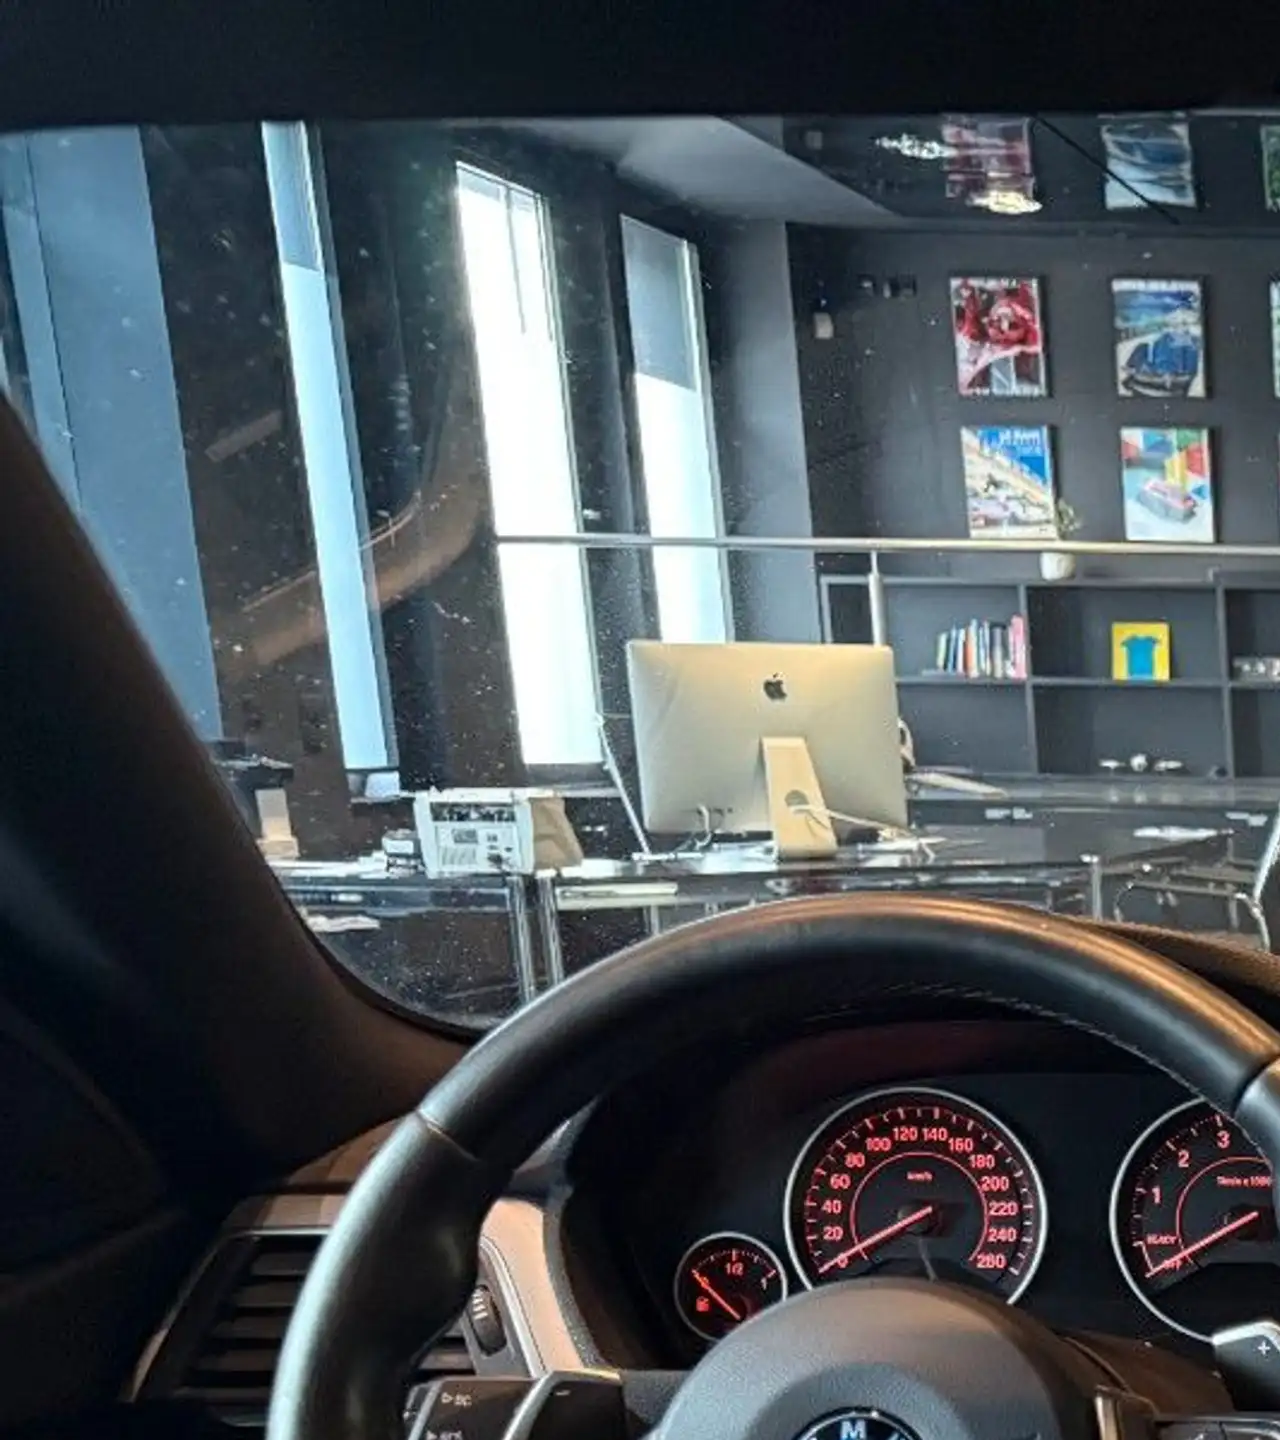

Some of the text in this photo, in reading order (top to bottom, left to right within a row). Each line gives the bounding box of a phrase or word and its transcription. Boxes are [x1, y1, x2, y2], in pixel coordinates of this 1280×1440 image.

[893, 1127, 918, 1141] 120
[923, 1128, 948, 1142] 140
[1217, 1130, 1231, 1149] 3
[865, 1137, 892, 1151] 100
[949, 1138, 974, 1152] 160
[845, 1153, 866, 1168] 80
[968, 1154, 995, 1169] 180
[1178, 1150, 1189, 1168] 2
[830, 1174, 850, 1190] 60
[980, 1176, 1009, 1191] 200
[1152, 1186, 1161, 1204] 1
[822, 1200, 842, 1214] 40
[988, 1201, 1019, 1216] 220
[823, 1226, 844, 1241] 20
[987, 1228, 1017, 1242] 240
[725, 1262, 744, 1276] 1/2
[976, 1254, 1007, 1269] 260
